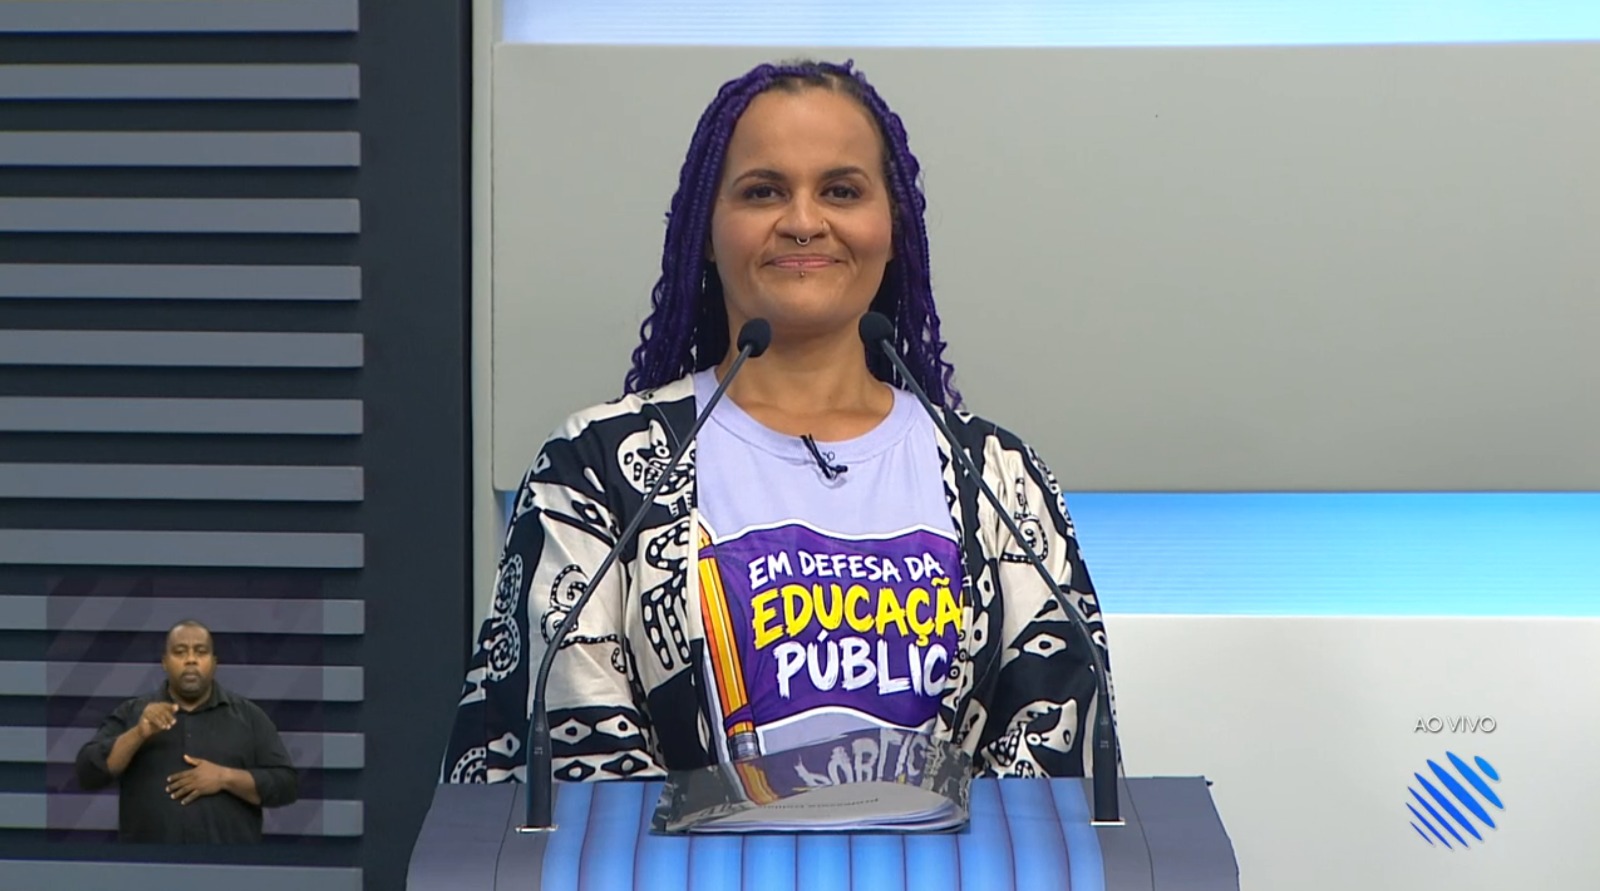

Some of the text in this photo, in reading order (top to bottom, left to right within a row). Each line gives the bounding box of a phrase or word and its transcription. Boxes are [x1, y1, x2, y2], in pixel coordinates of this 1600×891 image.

[748, 551, 944, 589] EM DEFESA DA
[751, 577, 964, 650] EDUCAÇÃ
[772, 631, 948, 699] PÚBLIC
